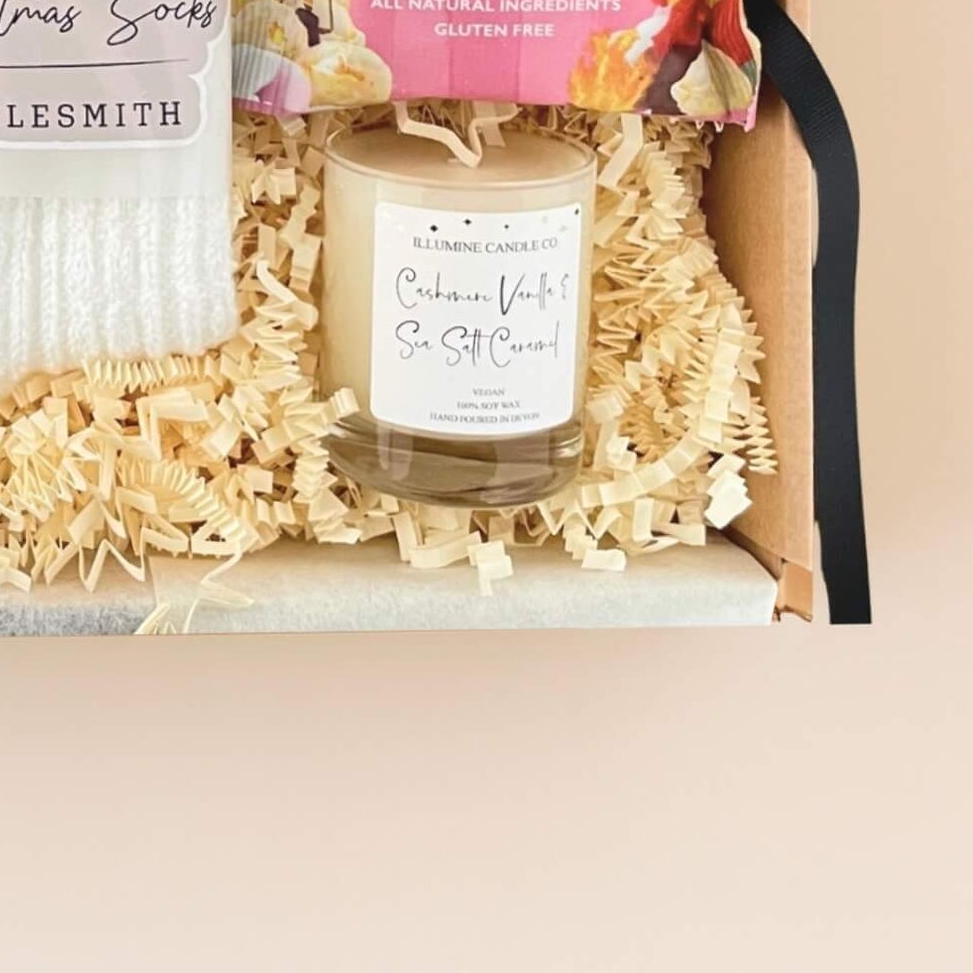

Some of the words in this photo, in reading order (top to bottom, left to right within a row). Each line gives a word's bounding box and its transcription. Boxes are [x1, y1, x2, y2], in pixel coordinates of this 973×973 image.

[434, 22, 507, 38] GLUTEN
[511, 23, 555, 38] FREE
[413, 237, 482, 253] ILLUMINE
[485, 239, 539, 254] CANDLE
[542, 237, 558, 249] CO
[396, 267, 493, 309] Cashmere
[395, 319, 434, 360] Sea
[441, 325, 491, 367] Salt
[472, 388, 506, 397] VEGAN
[481, 401, 499, 410] SOY
[430, 412, 458, 422] HAND
[460, 414, 498, 423] POURED
[499, 414, 509, 423] IN
